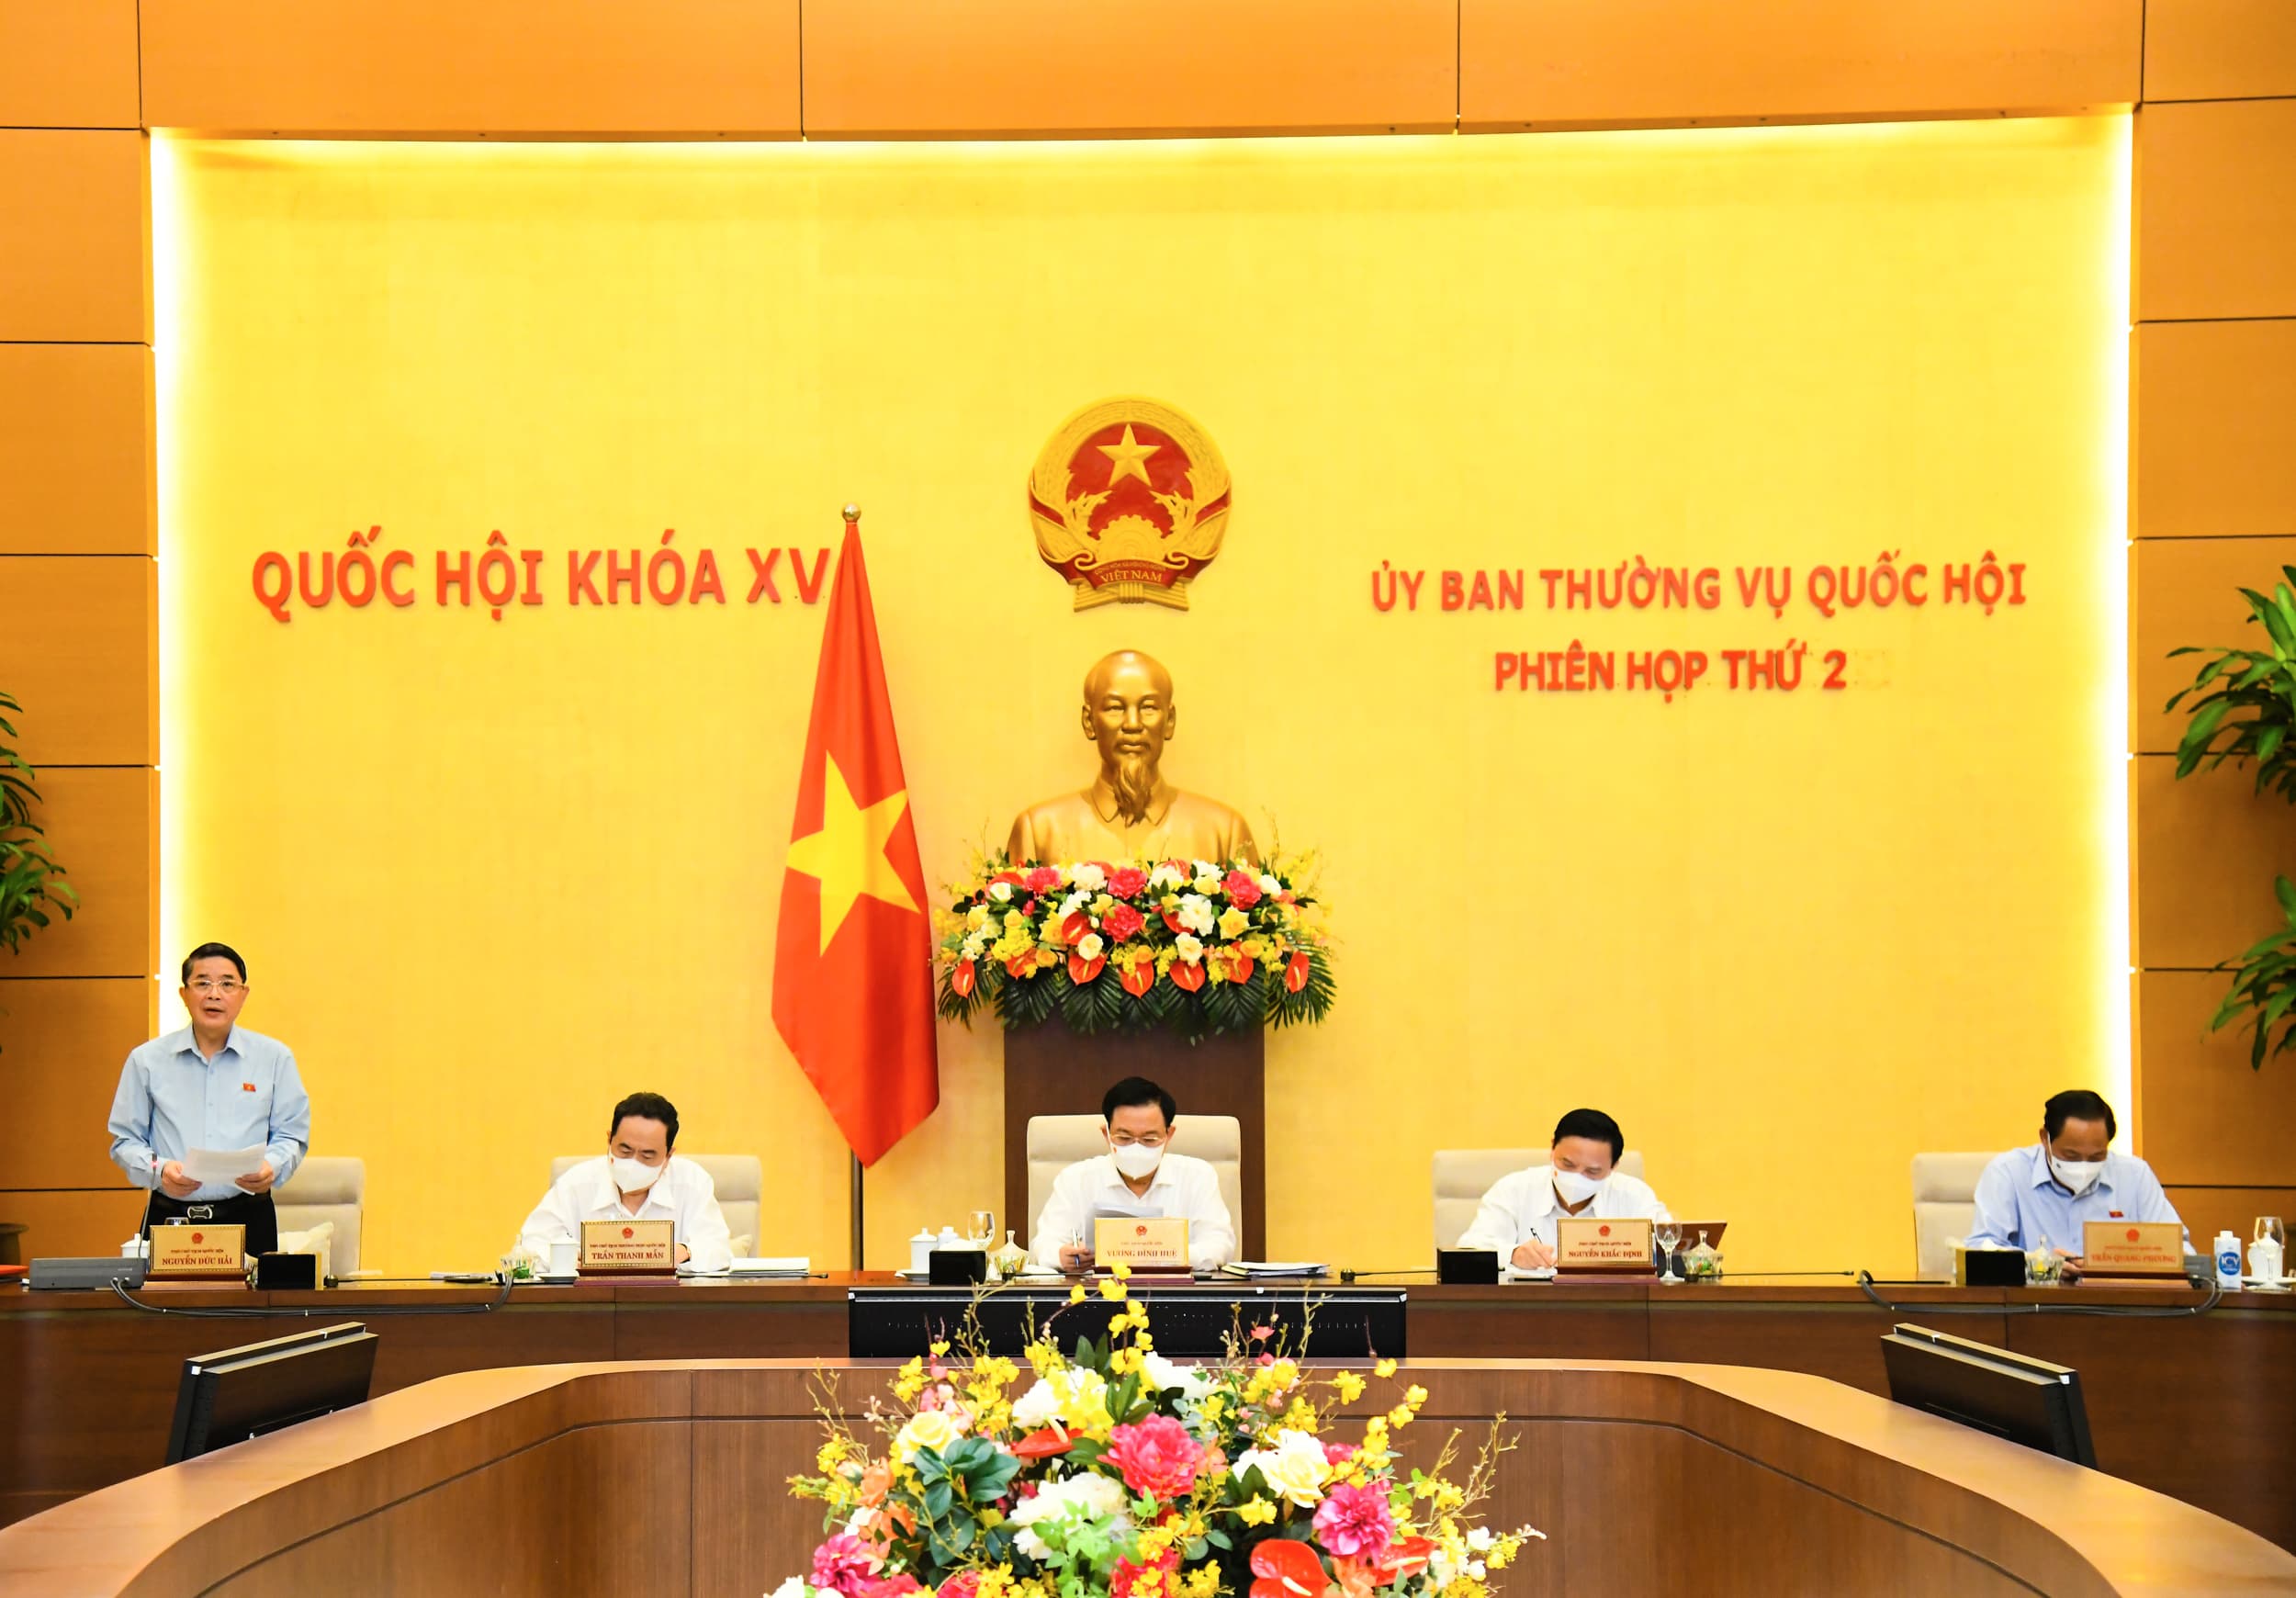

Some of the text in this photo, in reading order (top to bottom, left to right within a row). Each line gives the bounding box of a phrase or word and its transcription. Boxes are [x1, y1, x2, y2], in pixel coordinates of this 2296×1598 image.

[253, 526, 830, 623] QUỐC HỘI KHÓA XV
[1131, 570, 1162, 582] NAM
[1372, 550, 2026, 619] ỦY BAN THƯỜNG VỤ QUỐC HỘI
[1495, 638, 1847, 703] PHIÊN HỌP THỨ 2
